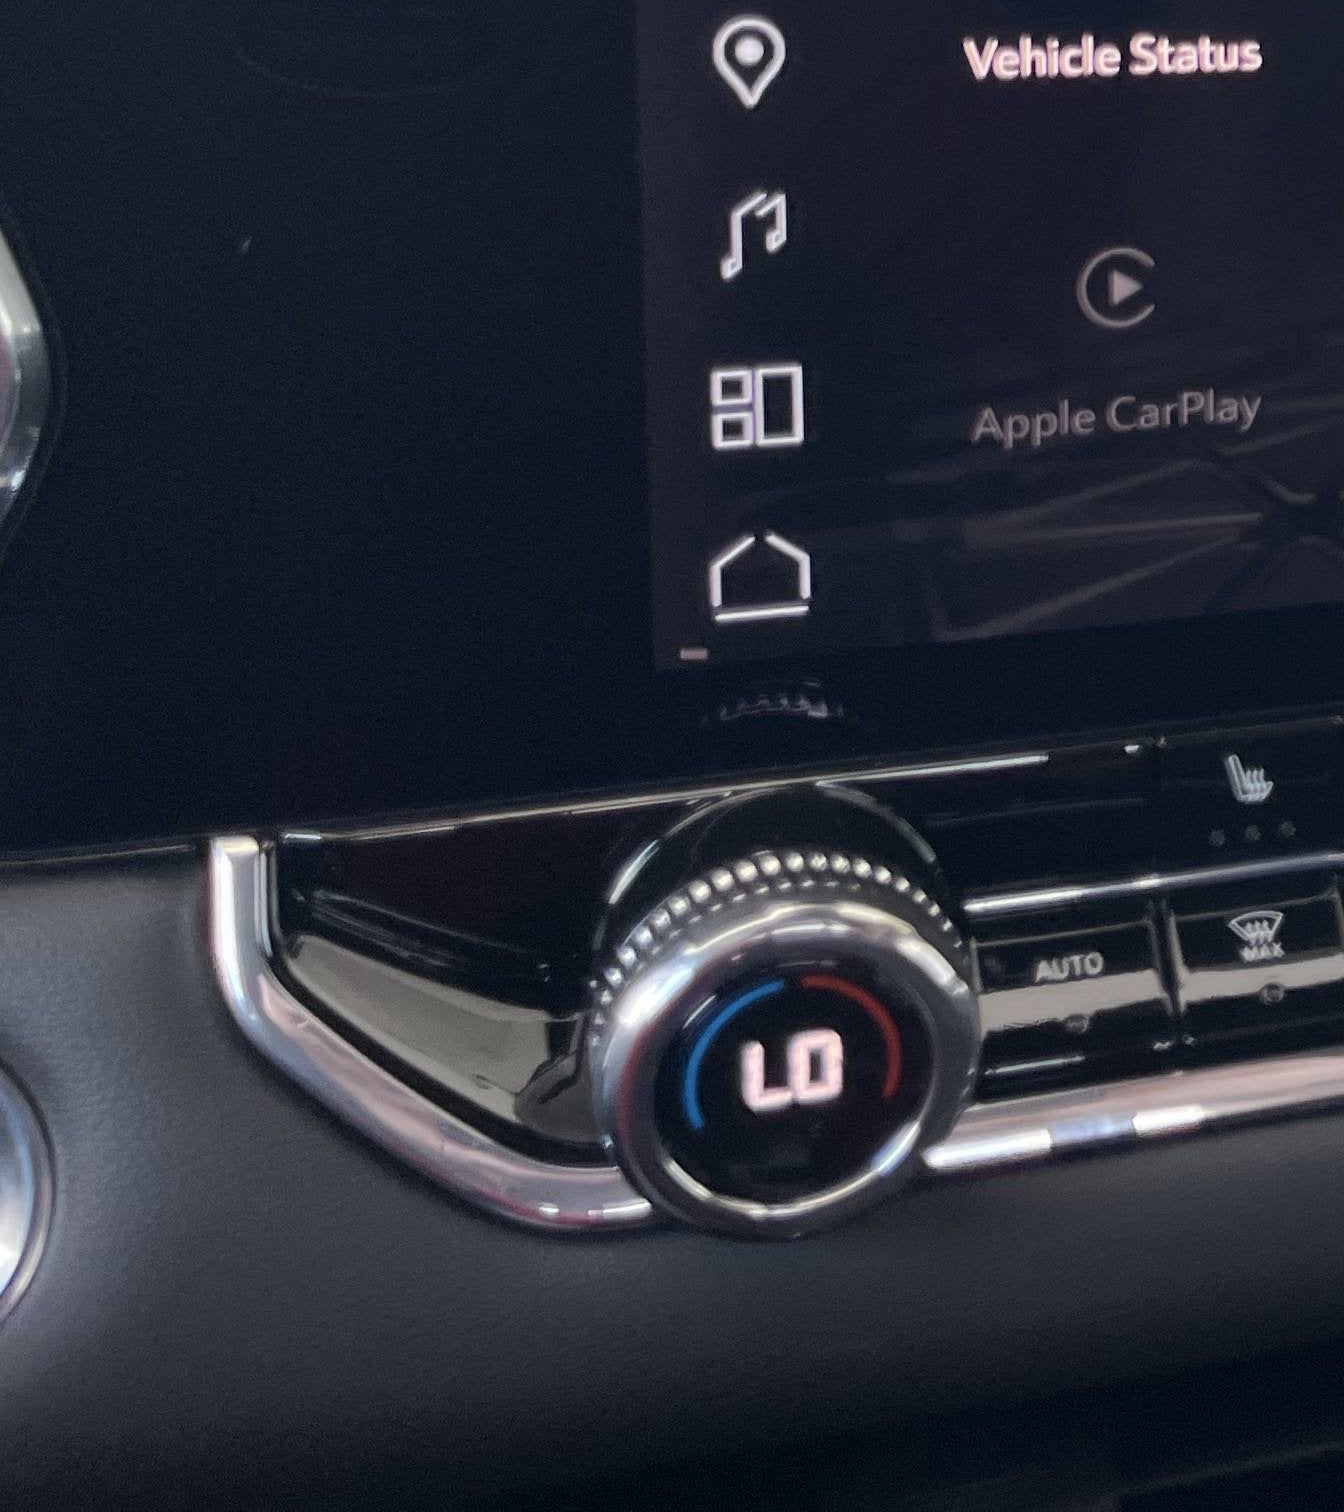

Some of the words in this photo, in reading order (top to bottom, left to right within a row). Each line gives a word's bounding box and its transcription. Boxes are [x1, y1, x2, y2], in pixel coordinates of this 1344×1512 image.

[963, 32, 1121, 81] Vehicle
[1128, 33, 1262, 75] Status
[969, 399, 1095, 448] Apple
[1106, 388, 1262, 432] CarPlay
[1035, 950, 1104, 985] AUTO
[740, 1026, 844, 1114] LO
